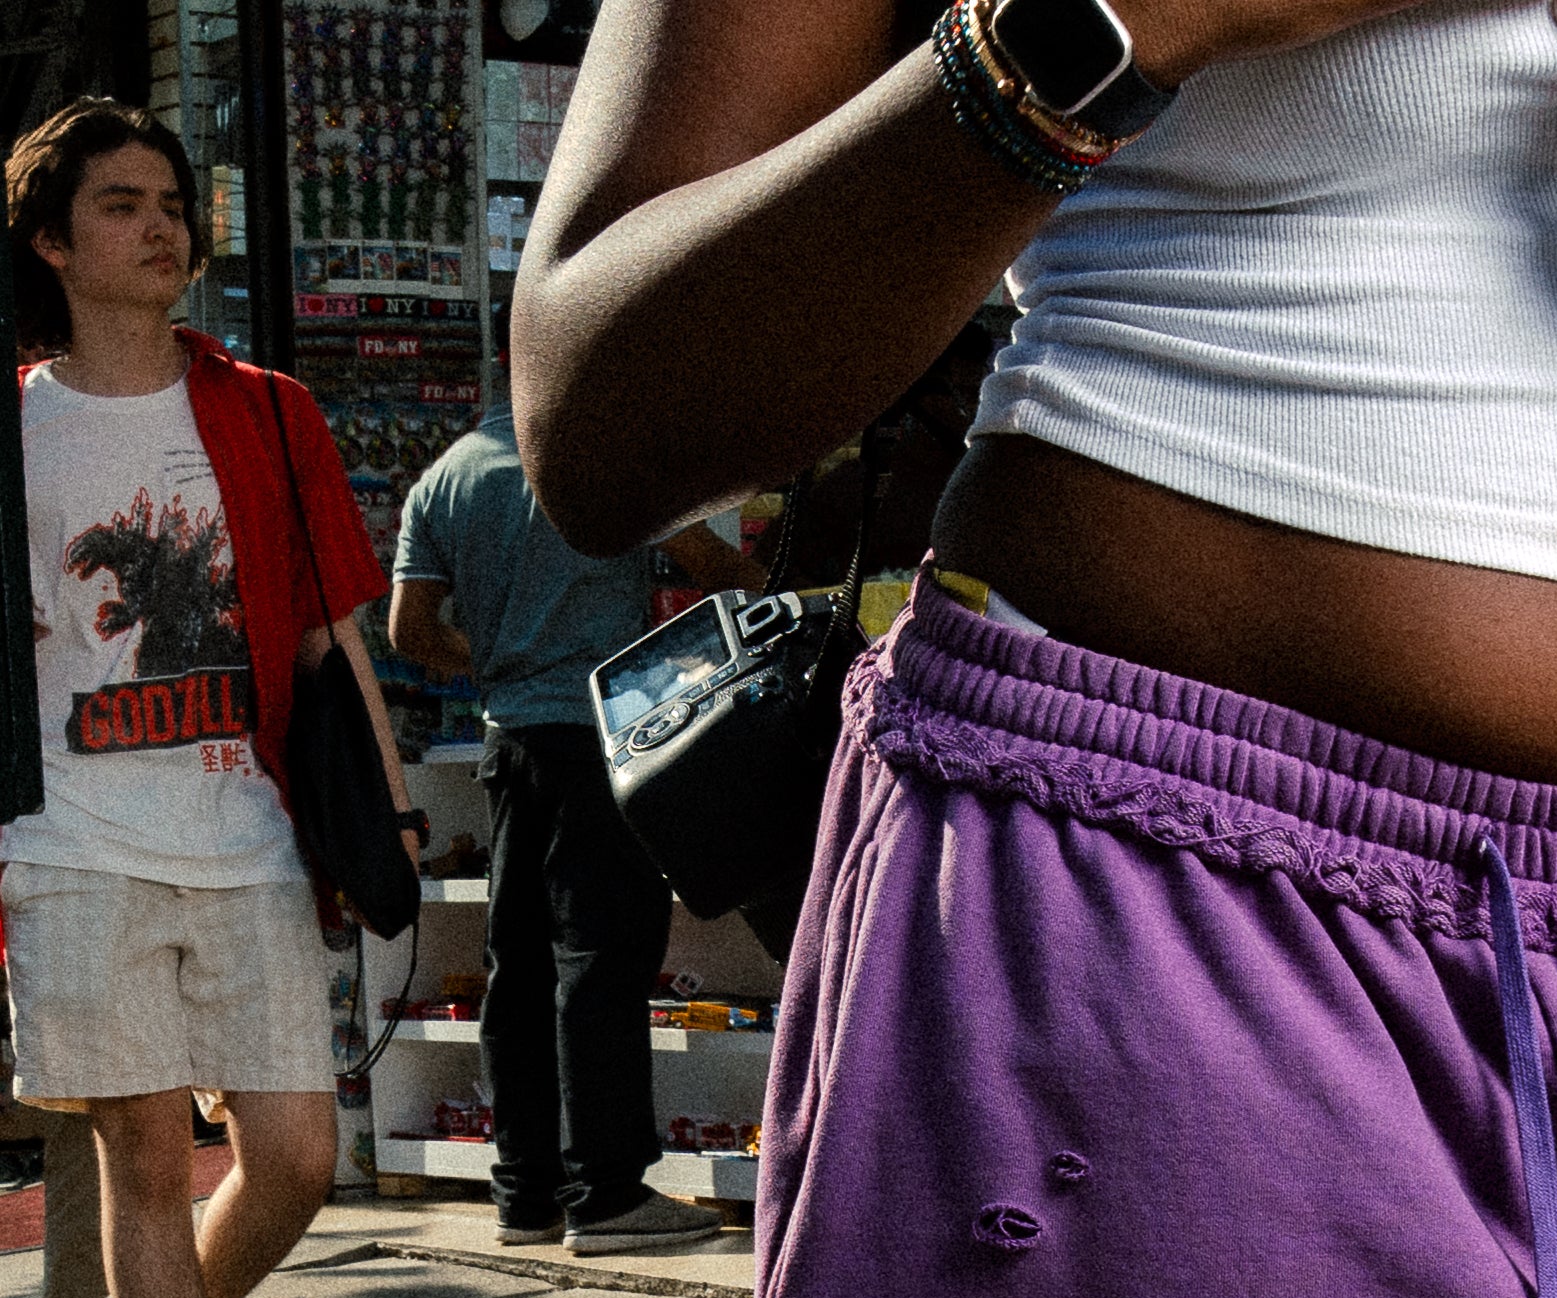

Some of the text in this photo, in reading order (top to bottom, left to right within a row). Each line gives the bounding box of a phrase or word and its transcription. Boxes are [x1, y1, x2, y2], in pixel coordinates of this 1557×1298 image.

[386, 296, 417, 314] NY
[364, 340, 419, 354] FD NY
